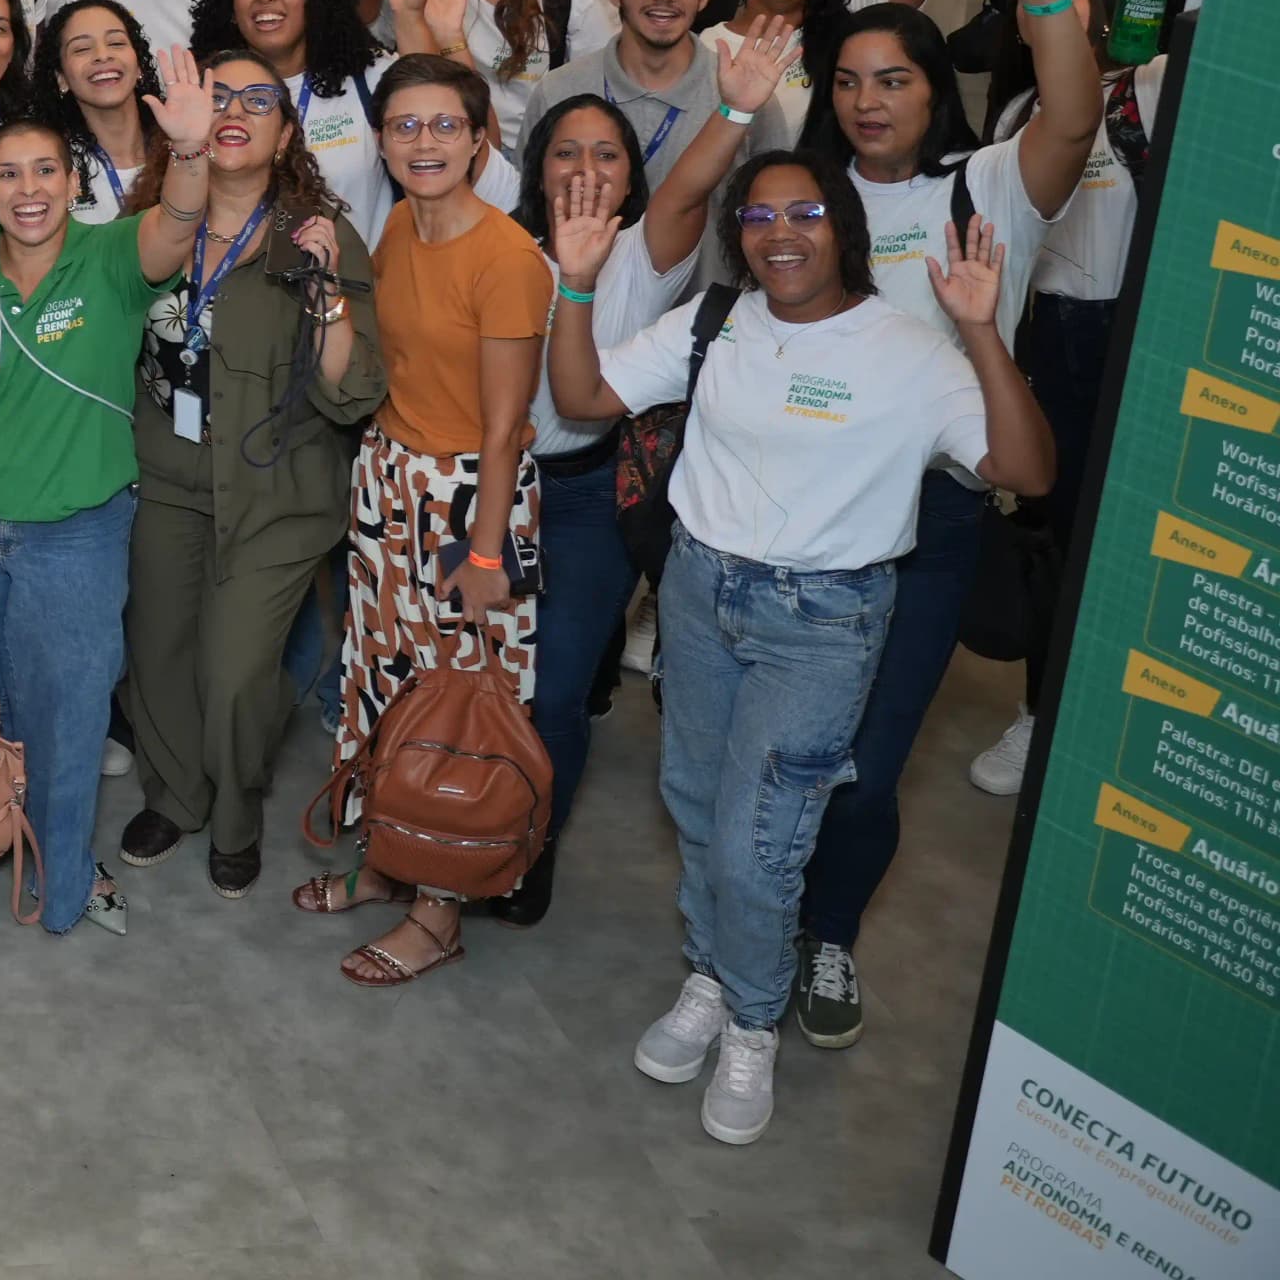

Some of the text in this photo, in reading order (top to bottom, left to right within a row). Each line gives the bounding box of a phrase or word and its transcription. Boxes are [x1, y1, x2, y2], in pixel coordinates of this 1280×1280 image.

[1230, 239, 1279, 266] Anexo
[36, 324, 42, 334] E
[786, 395, 829, 409] E RENDA
[788, 384, 853, 401] AUTONOMIA
[791, 372, 847, 390] PROGRAMA
[1199, 387, 1248, 415] Anexo
[1169, 530, 1217, 559] Anexo
[1188, 596, 1209, 615] de
[1193, 573, 1263, 617] Palestra
[1140, 668, 1188, 699] Anexo
[1179, 635, 1257, 683] Horários:
[1156, 740, 1270, 809] Profissionais:
[1161, 720, 1234, 769] Palestra:
[1238, 759, 1269, 785] DEI
[1111, 802, 1158, 833] Anexo
[1152, 760, 1228, 810] Horários:
[1234, 801, 1265, 829] 11h
[1136, 843, 1181, 880] Troca
[1185, 873, 1206, 892] de
[1192, 839, 1280, 895] Aquário
[1126, 883, 1237, 953] Profissionais:
[1131, 864, 1273, 950] Indústria de Óleo
[1122, 902, 1275, 997] Horários: 14h30 às
[1007, 1142, 1103, 1211] PROGRAMA
[1016, 1099, 1240, 1246] Evento de Empregabilidade
[1020, 1079, 1253, 1231] CONECTA FUTURO
[1000, 1174, 1106, 1251] PETROBRAS
[1003, 1161, 1112, 1237] AUTONOMIA
[1116, 1232, 1130, 1247] E
